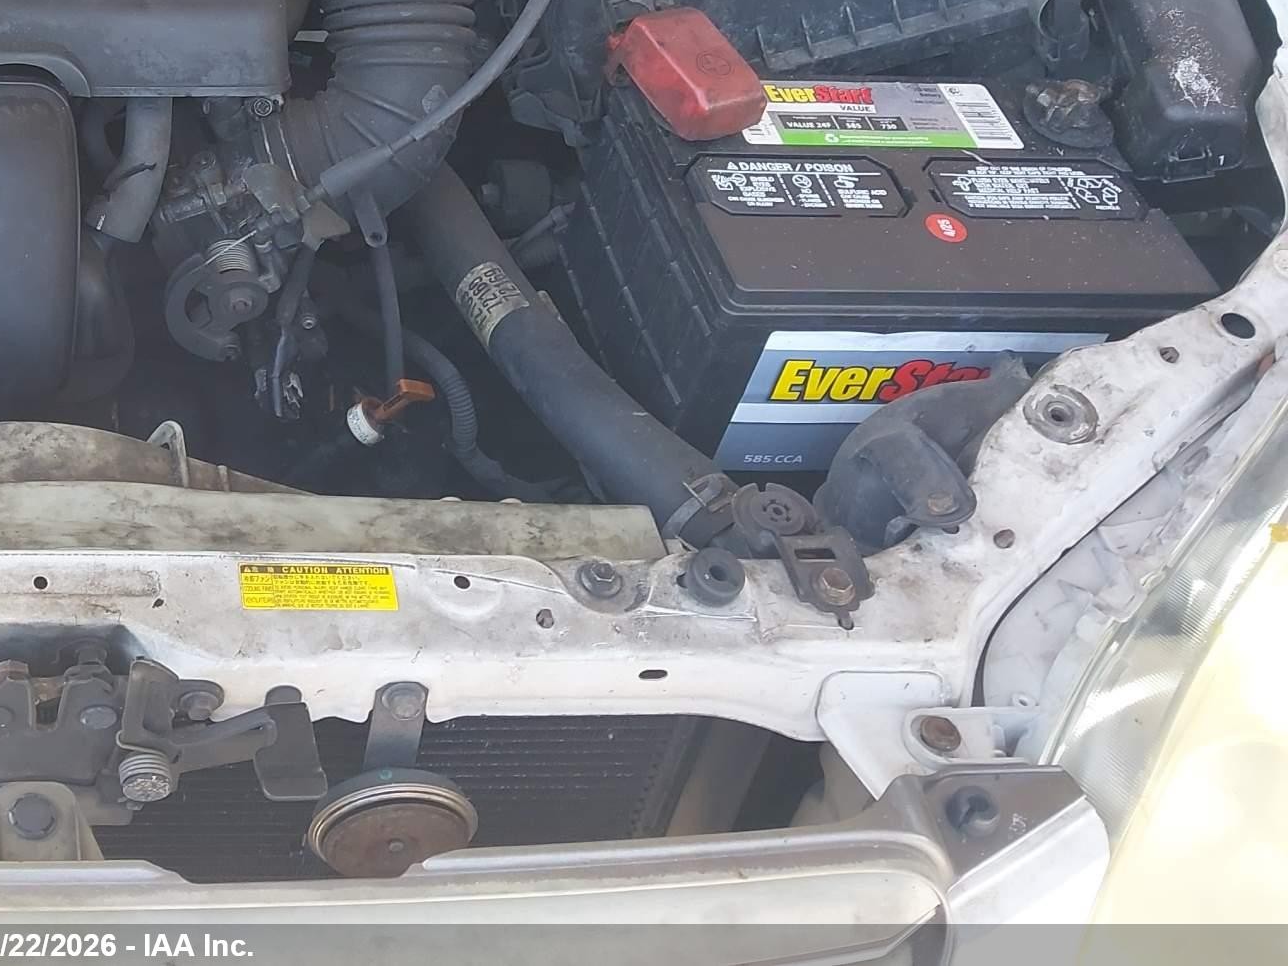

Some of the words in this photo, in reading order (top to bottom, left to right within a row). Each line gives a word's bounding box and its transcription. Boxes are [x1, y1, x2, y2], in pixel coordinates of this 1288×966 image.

[763, 84, 874, 104] EverStart
[738, 162, 793, 172] DANGER
[804, 163, 855, 173] POISON
[743, 454, 772, 464] 585
[774, 454, 803, 464] CCA
[282, 566, 328, 574] CAUTION
[335, 566, 387, 575] ATTENTION
